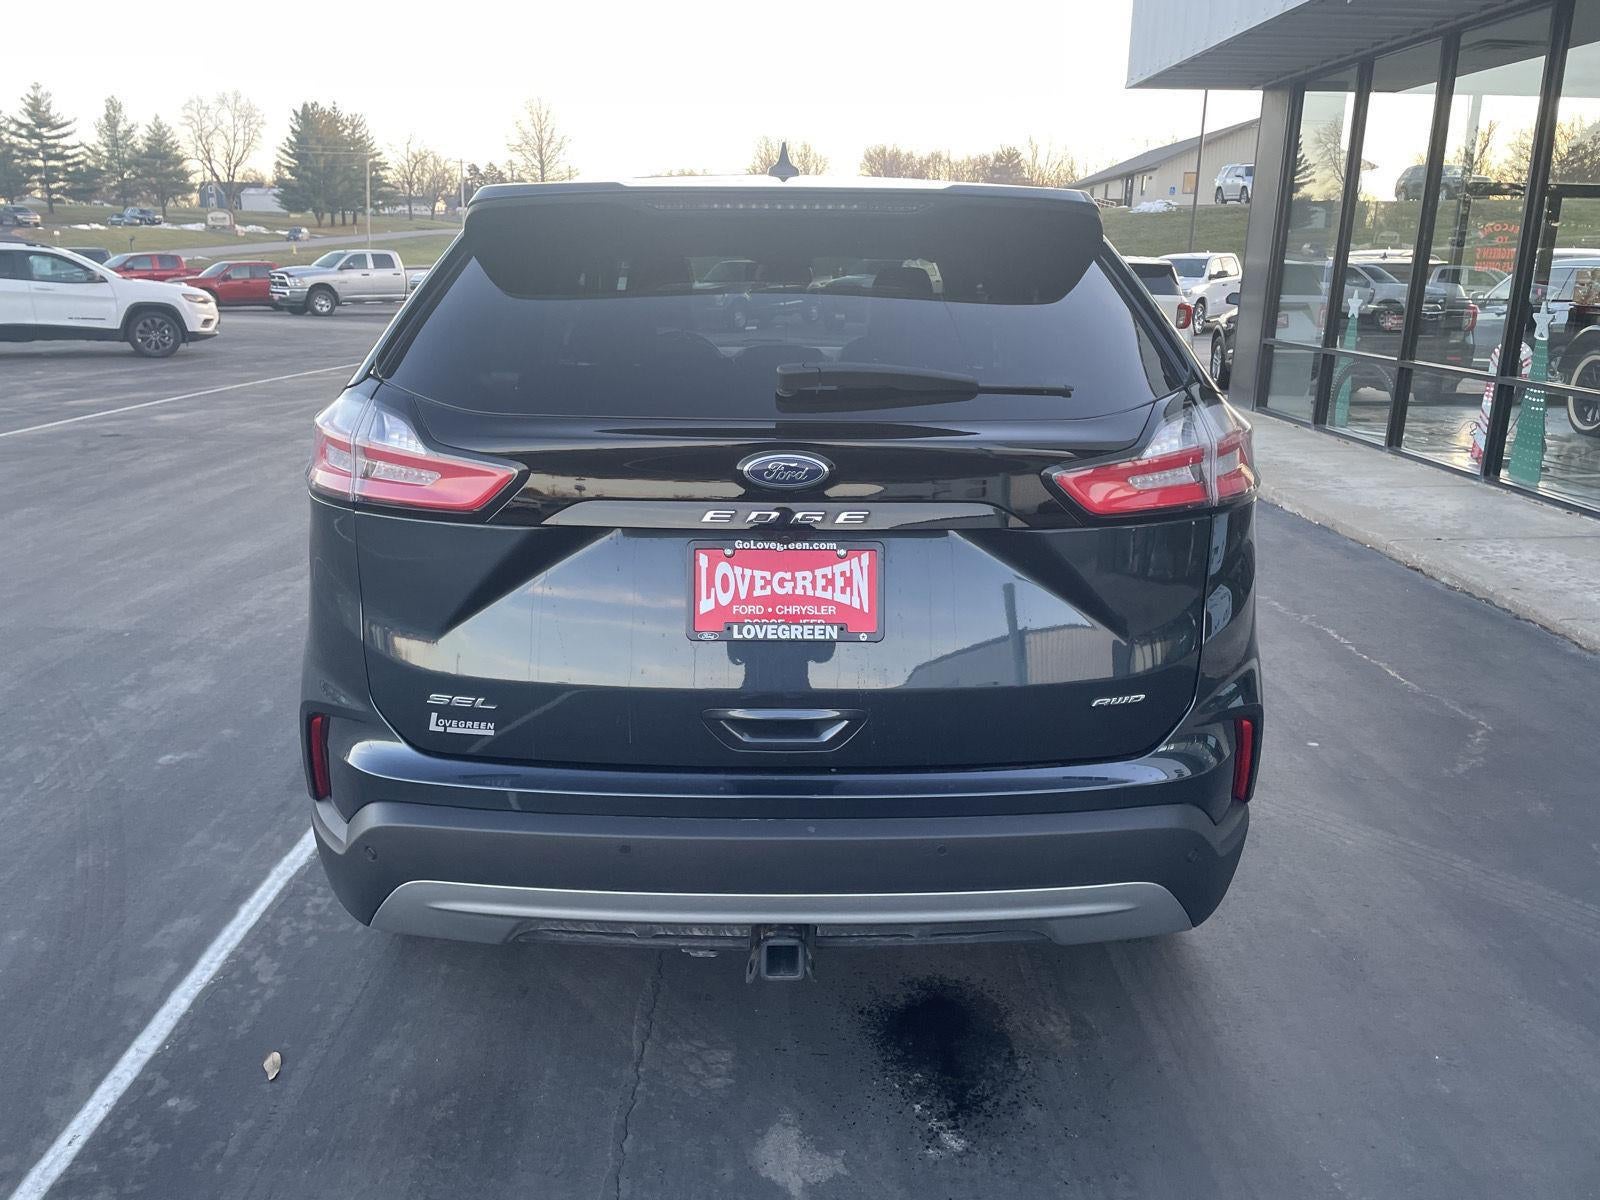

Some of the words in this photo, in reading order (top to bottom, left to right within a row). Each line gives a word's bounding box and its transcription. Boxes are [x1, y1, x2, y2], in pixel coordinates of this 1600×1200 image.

[763, 461, 808, 481] Ford
[701, 510, 870, 524] EDGE
[699, 551, 869, 615] LOVEGREEN
[732, 605, 765, 615] FORD
[776, 605, 837, 615] CHRYSLER
[732, 624, 838, 640] LOVEGREEN
[426, 693, 498, 710] SEL
[1091, 694, 1146, 707] AWD
